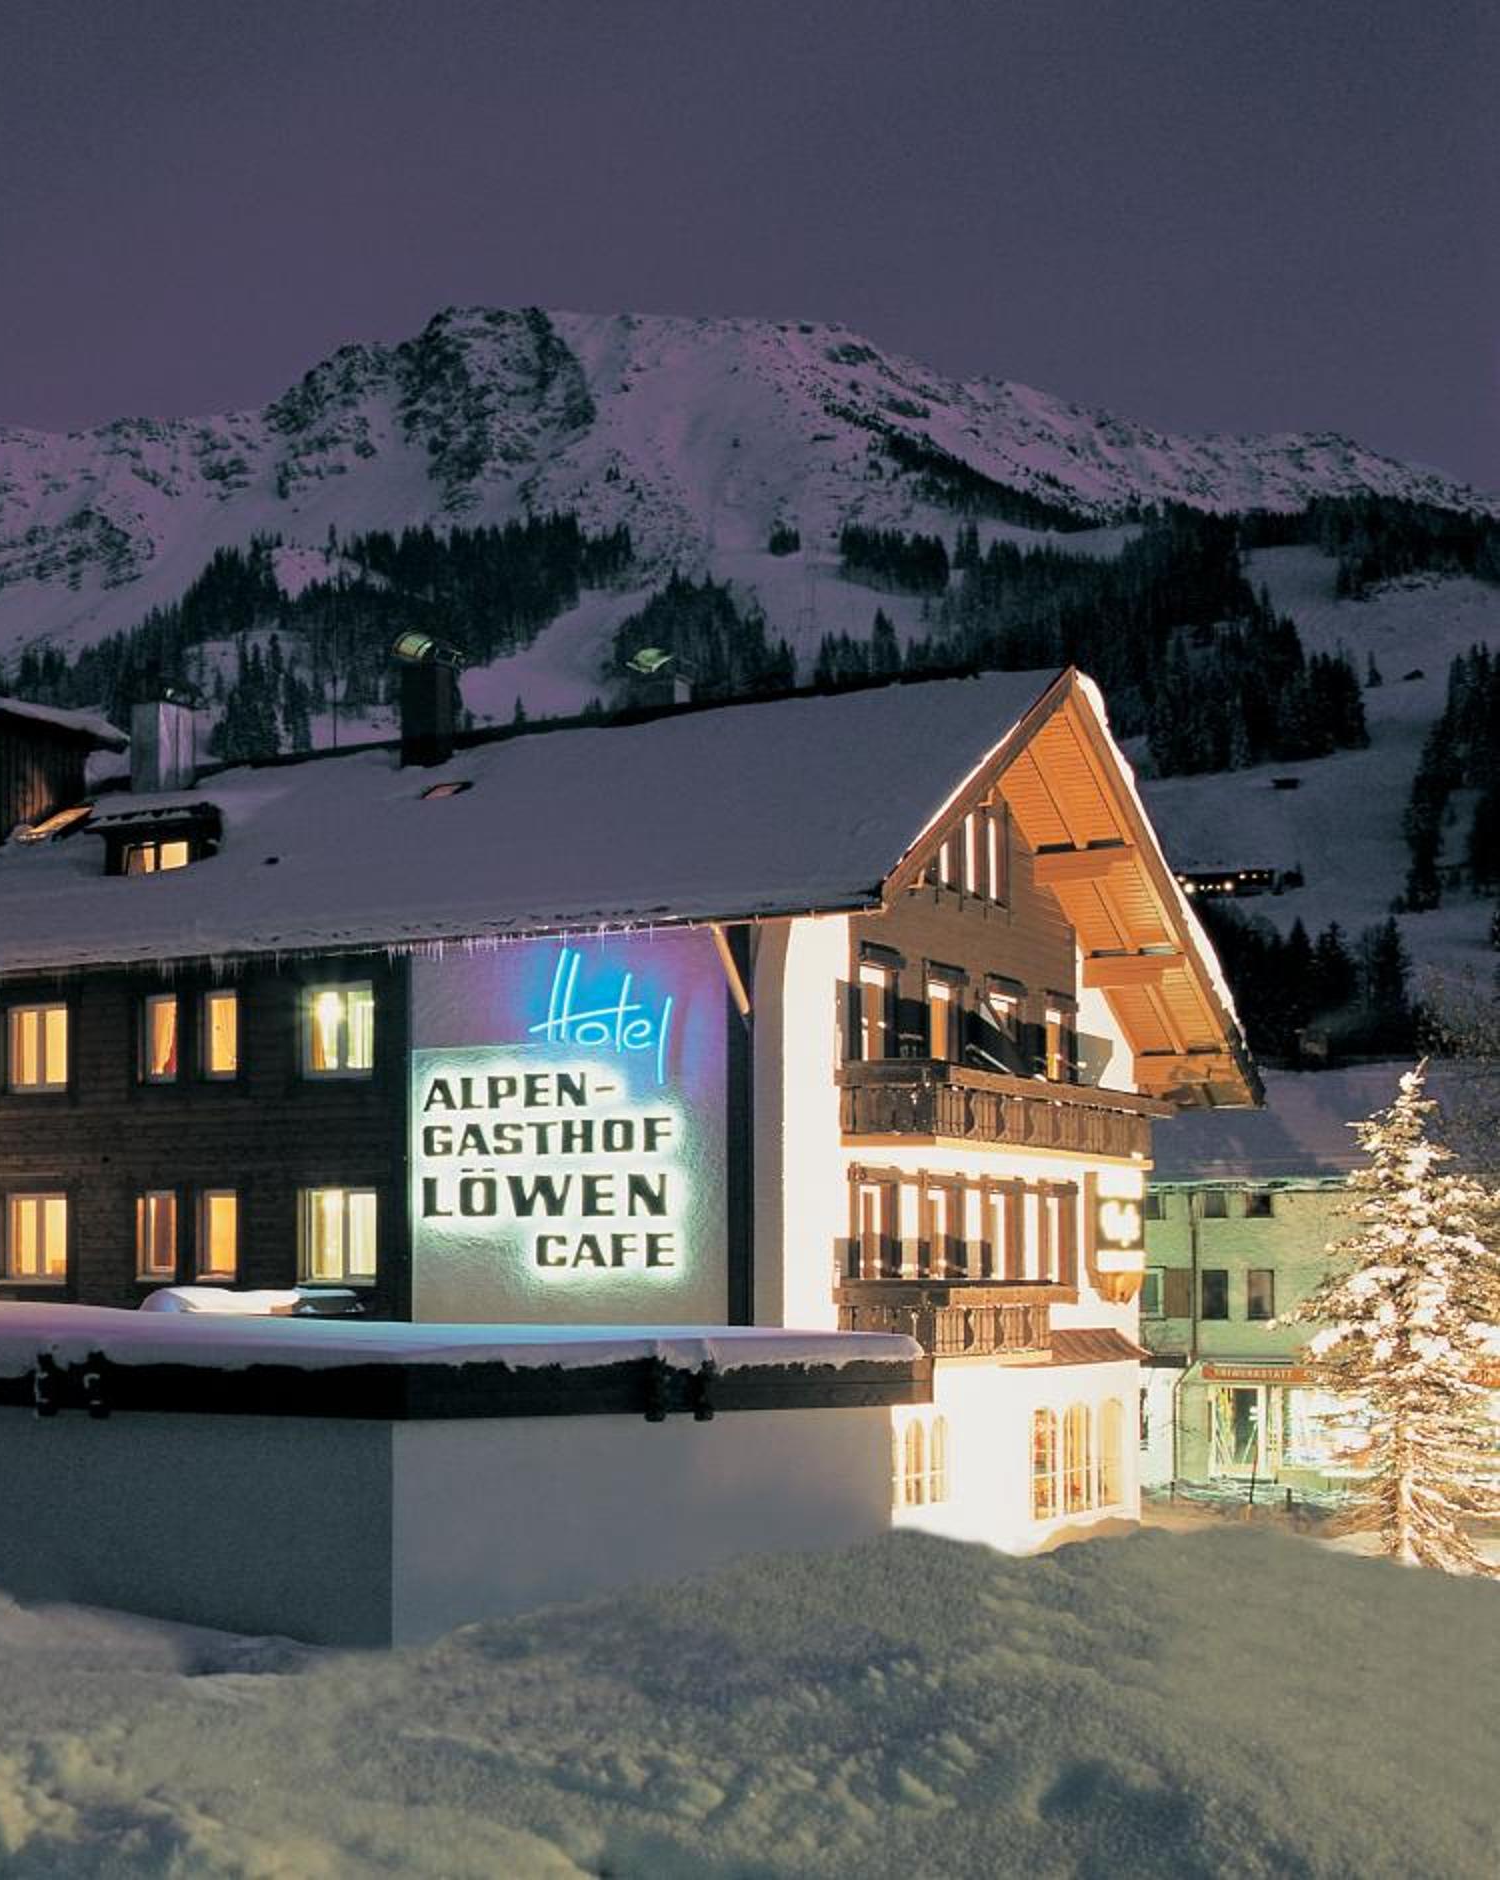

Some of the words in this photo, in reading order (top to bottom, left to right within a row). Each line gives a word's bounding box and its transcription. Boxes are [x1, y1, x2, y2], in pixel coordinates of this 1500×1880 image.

[528, 947, 673, 1085] Hotel
[423, 1072, 616, 1112] ALPEN-
[422, 1117, 672, 1157] GASTHOF
[422, 1167, 668, 1218] LÖWEN
[535, 1233, 676, 1268] CAFE
